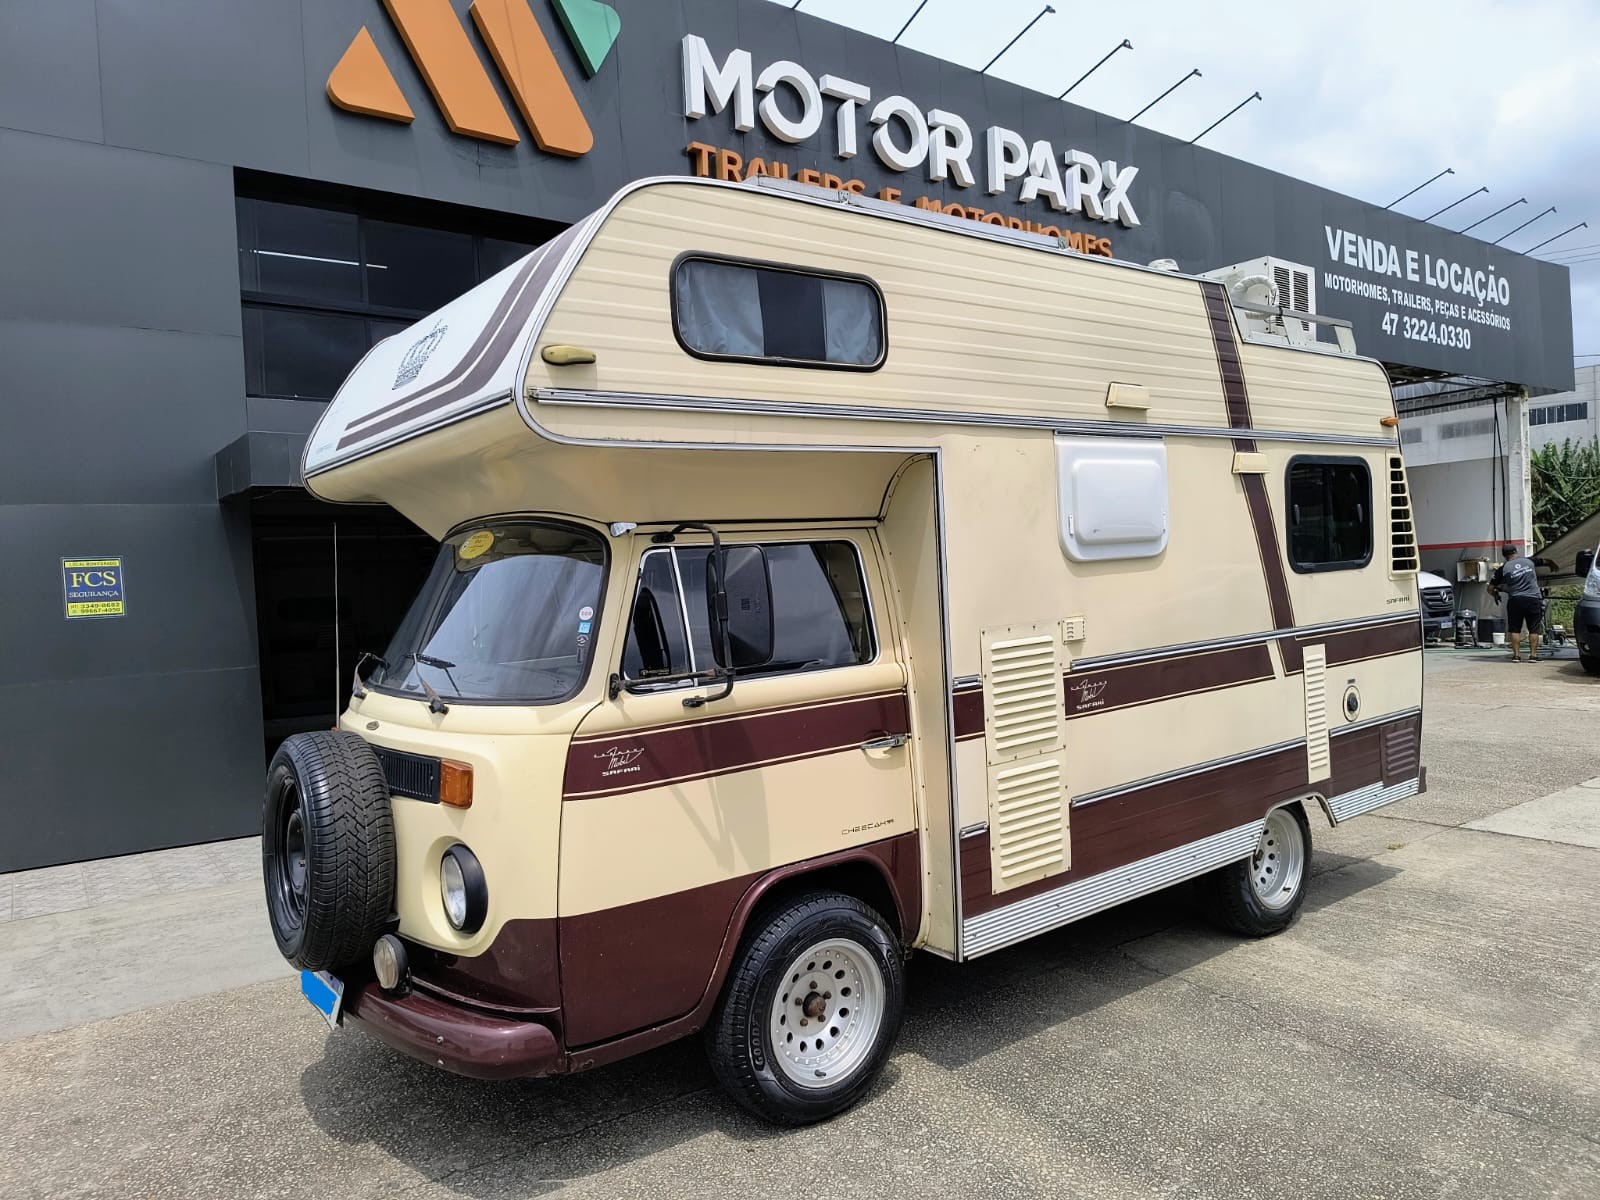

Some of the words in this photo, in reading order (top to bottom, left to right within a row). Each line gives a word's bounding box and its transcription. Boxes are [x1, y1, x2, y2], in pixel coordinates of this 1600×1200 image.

[681, 33, 975, 189] MOTOR
[986, 125, 1141, 227] PARK
[1324, 225, 1402, 279] VENDA
[1405, 249, 1420, 282] E
[1424, 254, 1510, 307] LOCAÇÃO
[1324, 273, 1390, 304] MOTORHOMES,
[1391, 289, 1434, 315] TRAILERS,
[1435, 299, 1459, 319] PEÇAS
[1461, 306, 1466, 319] E
[1468, 308, 1511, 331] ACESSÓRIOS
[1381, 312, 1398, 336] 47
[1402, 316, 1471, 350] 3224.0330
[70, 571, 117, 588] FCS
